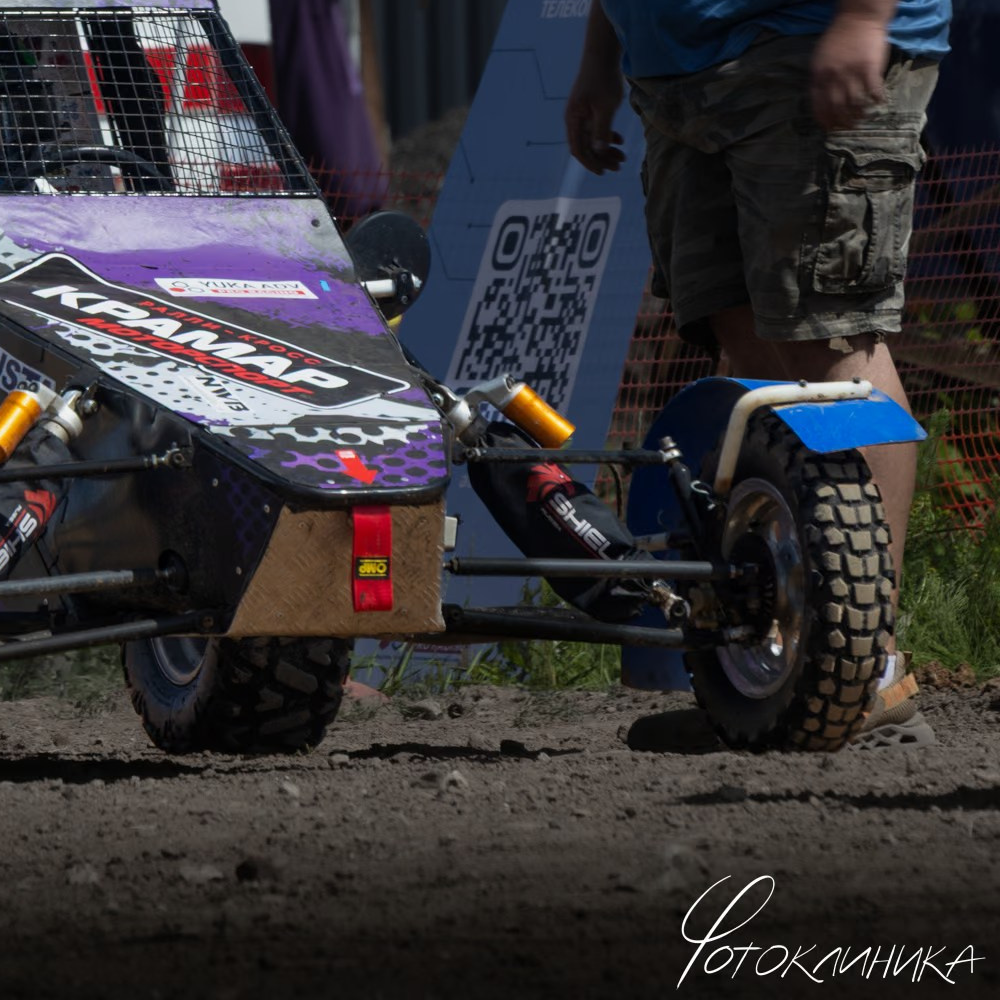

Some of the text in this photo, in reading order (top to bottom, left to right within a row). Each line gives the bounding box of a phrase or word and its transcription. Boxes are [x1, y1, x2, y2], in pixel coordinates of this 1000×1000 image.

[541, 0, 594, 18] ТЕЛЕКО
[199, 280, 254, 289] YUKA
[32, 284, 349, 389] КРАМАР
[75, 317, 315, 395] МОТОРСПОРТ
[552, 492, 624, 561] SHIEL
[358, 562, 388, 574] OMP
